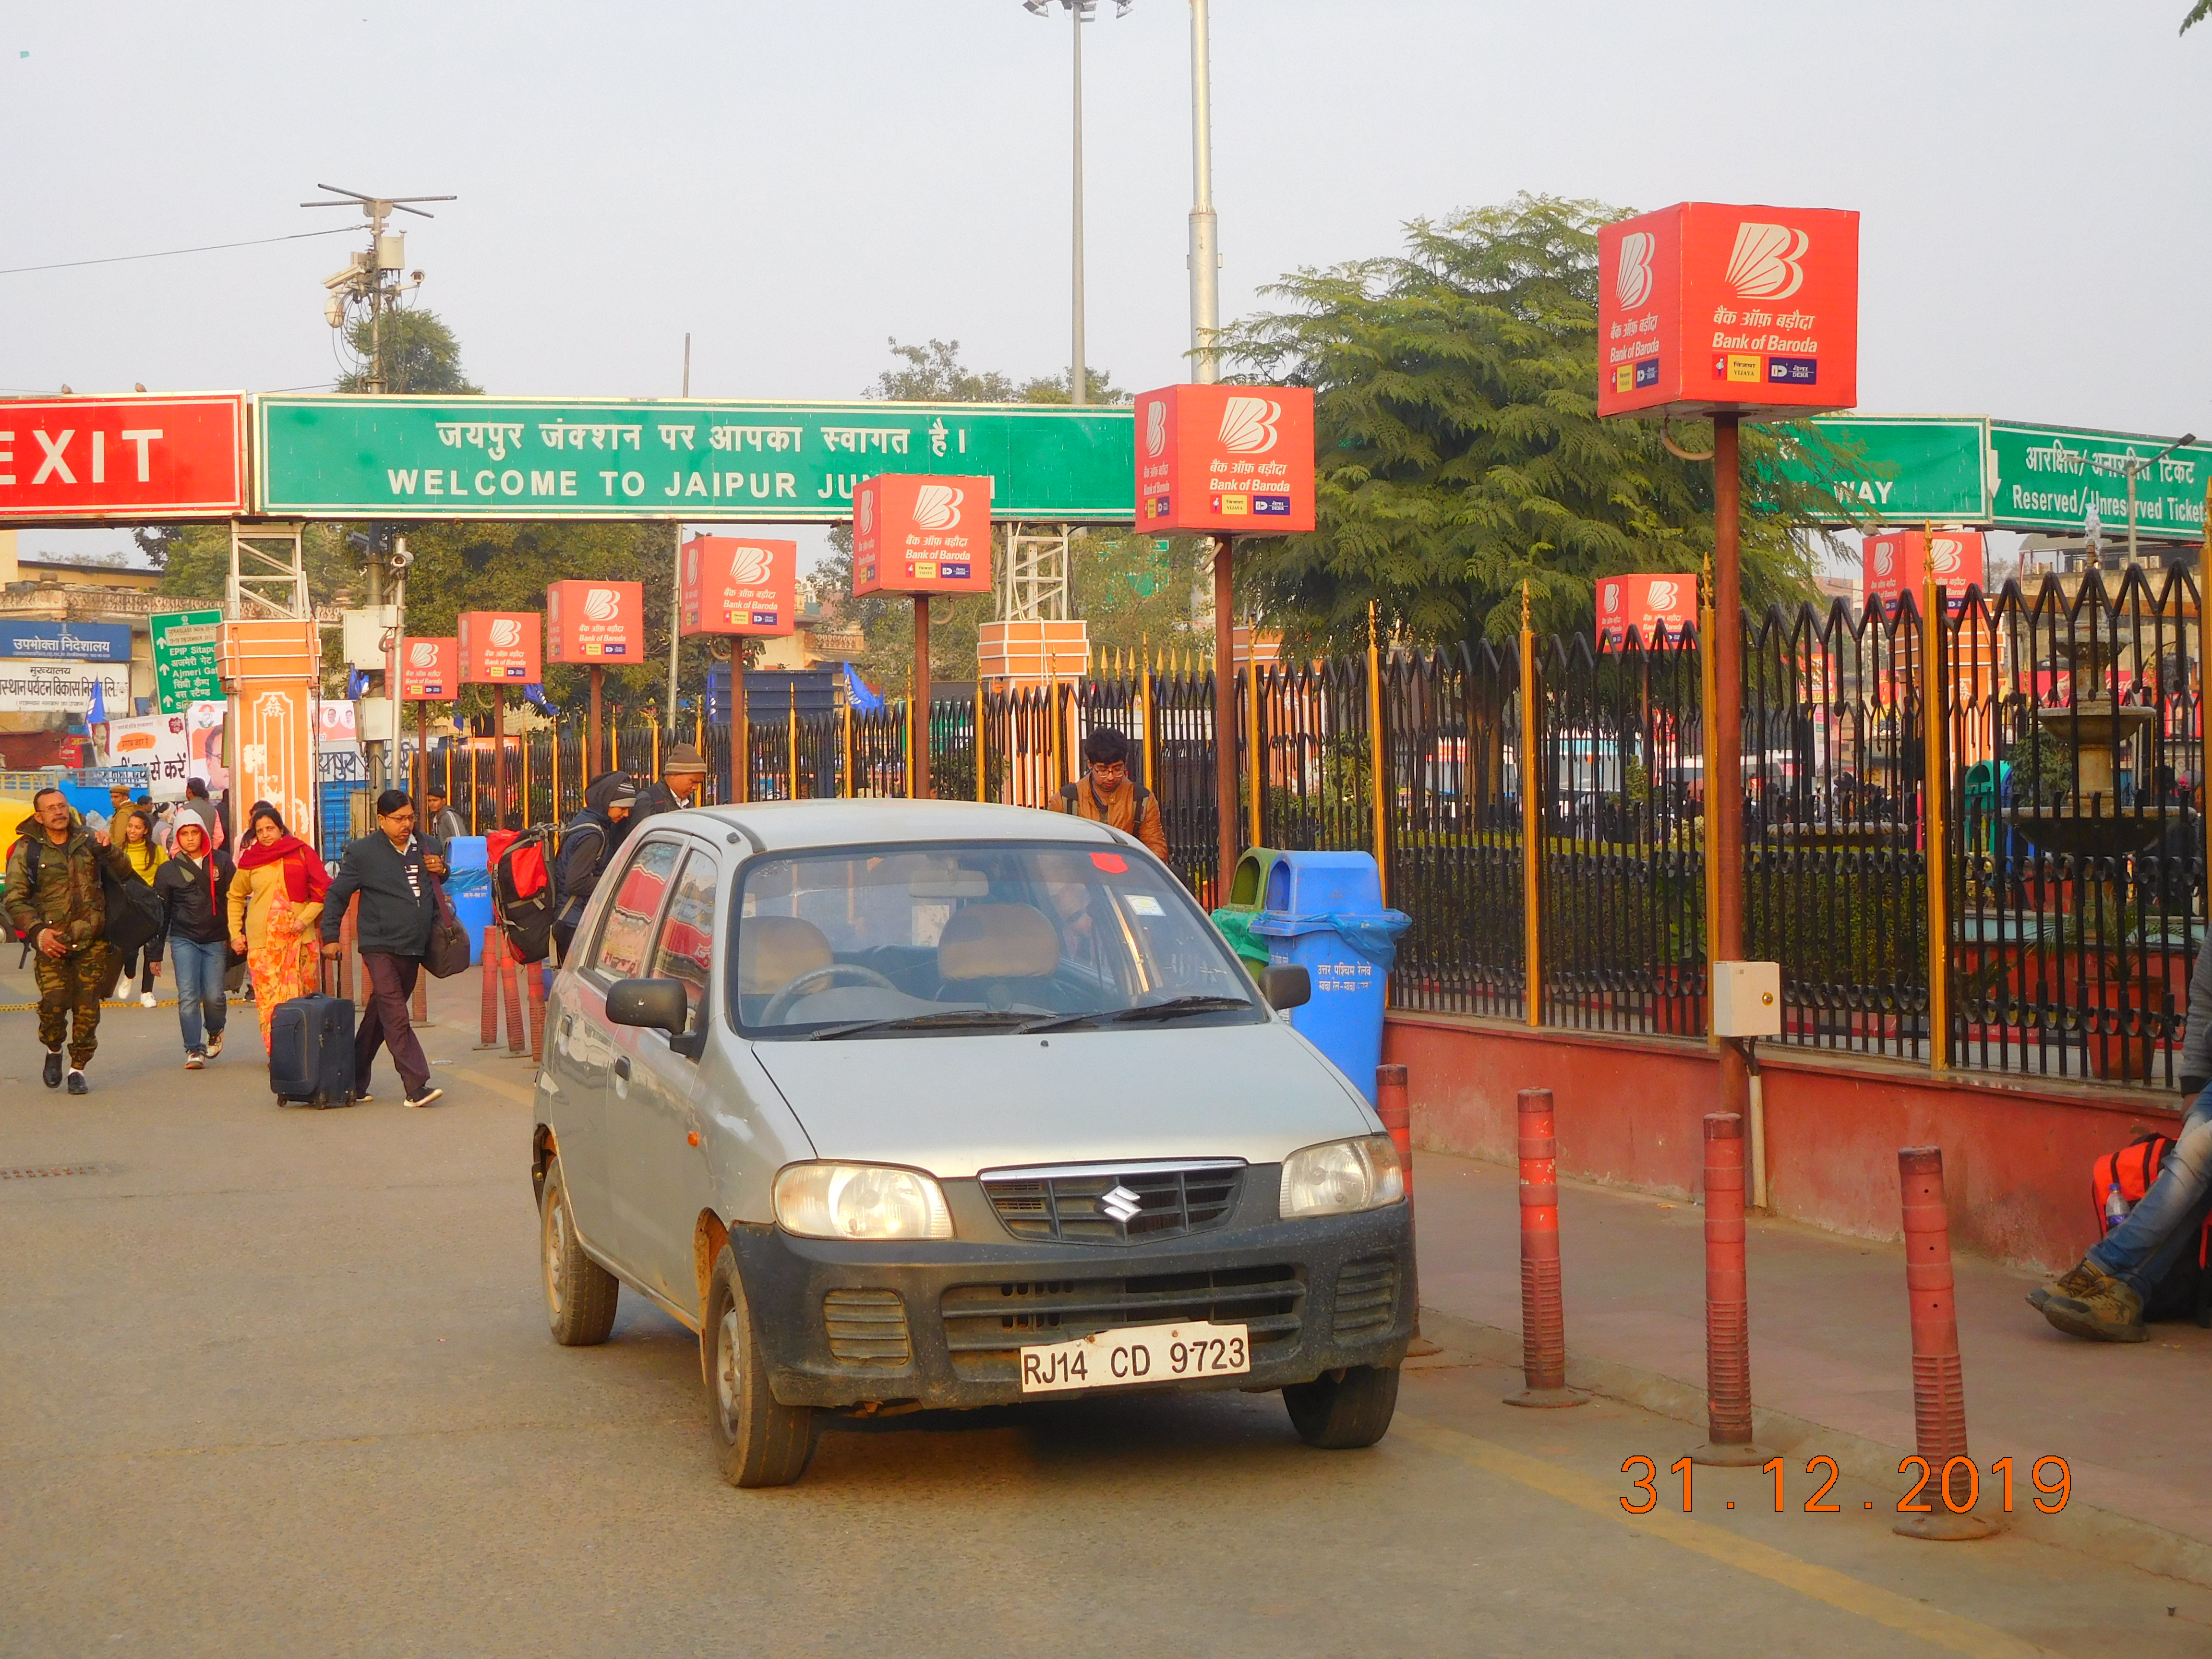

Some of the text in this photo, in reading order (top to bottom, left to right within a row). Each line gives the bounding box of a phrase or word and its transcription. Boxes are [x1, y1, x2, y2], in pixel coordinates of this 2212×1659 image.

[1714, 305, 1738, 325] बैंक
[1776, 309, 1815, 331] बड़ौदा
[1610, 337, 1659, 363] Bank of Baroda
[1712, 332, 1817, 353] Bank of Baroda
[435, 422, 524, 461] जयपुर
[539, 418, 642, 450] जंक्शन
[658, 424, 695, 450] पर
[710, 425, 803, 452] आपका
[820, 426, 911, 454] स्वागत
[1210, 458, 1228, 473] बैंक
[1258, 460, 1287, 476] बड़ौदा
[387, 469, 577, 496] WELCOME
[600, 470, 645, 497] TO
[665, 470, 797, 499] JAIPUR
[1210, 478, 1290, 492] Bank of Baroda
[2091, 490, 2162, 520] Unresrved
[906, 534, 921, 545] बैंक
[944, 535, 969, 548] बड़ौदा
[905, 549, 971, 560] Bank of Baroda
[723, 600, 742, 608] Bank
[752, 601, 778, 610] Baroda
[13, 636, 110, 652] उपभोक्ता निदेशालय
[170, 647, 187, 656] EPIP
[200, 655, 212, 665] गेट
[30, 666, 71, 677] मुख्यालय
[172, 668, 202, 678] Ajmeri
[27, 676, 51, 696] पर्यटन
[53, 676, 81, 696] विकास
[150, 754, 161, 781] से
[164, 752, 186, 779] करें
[1318, 961, 1372, 976] उत्तर पश्चिम रेलवे
[1024, 1337, 1245, 1385] RJ14 CD 9723
